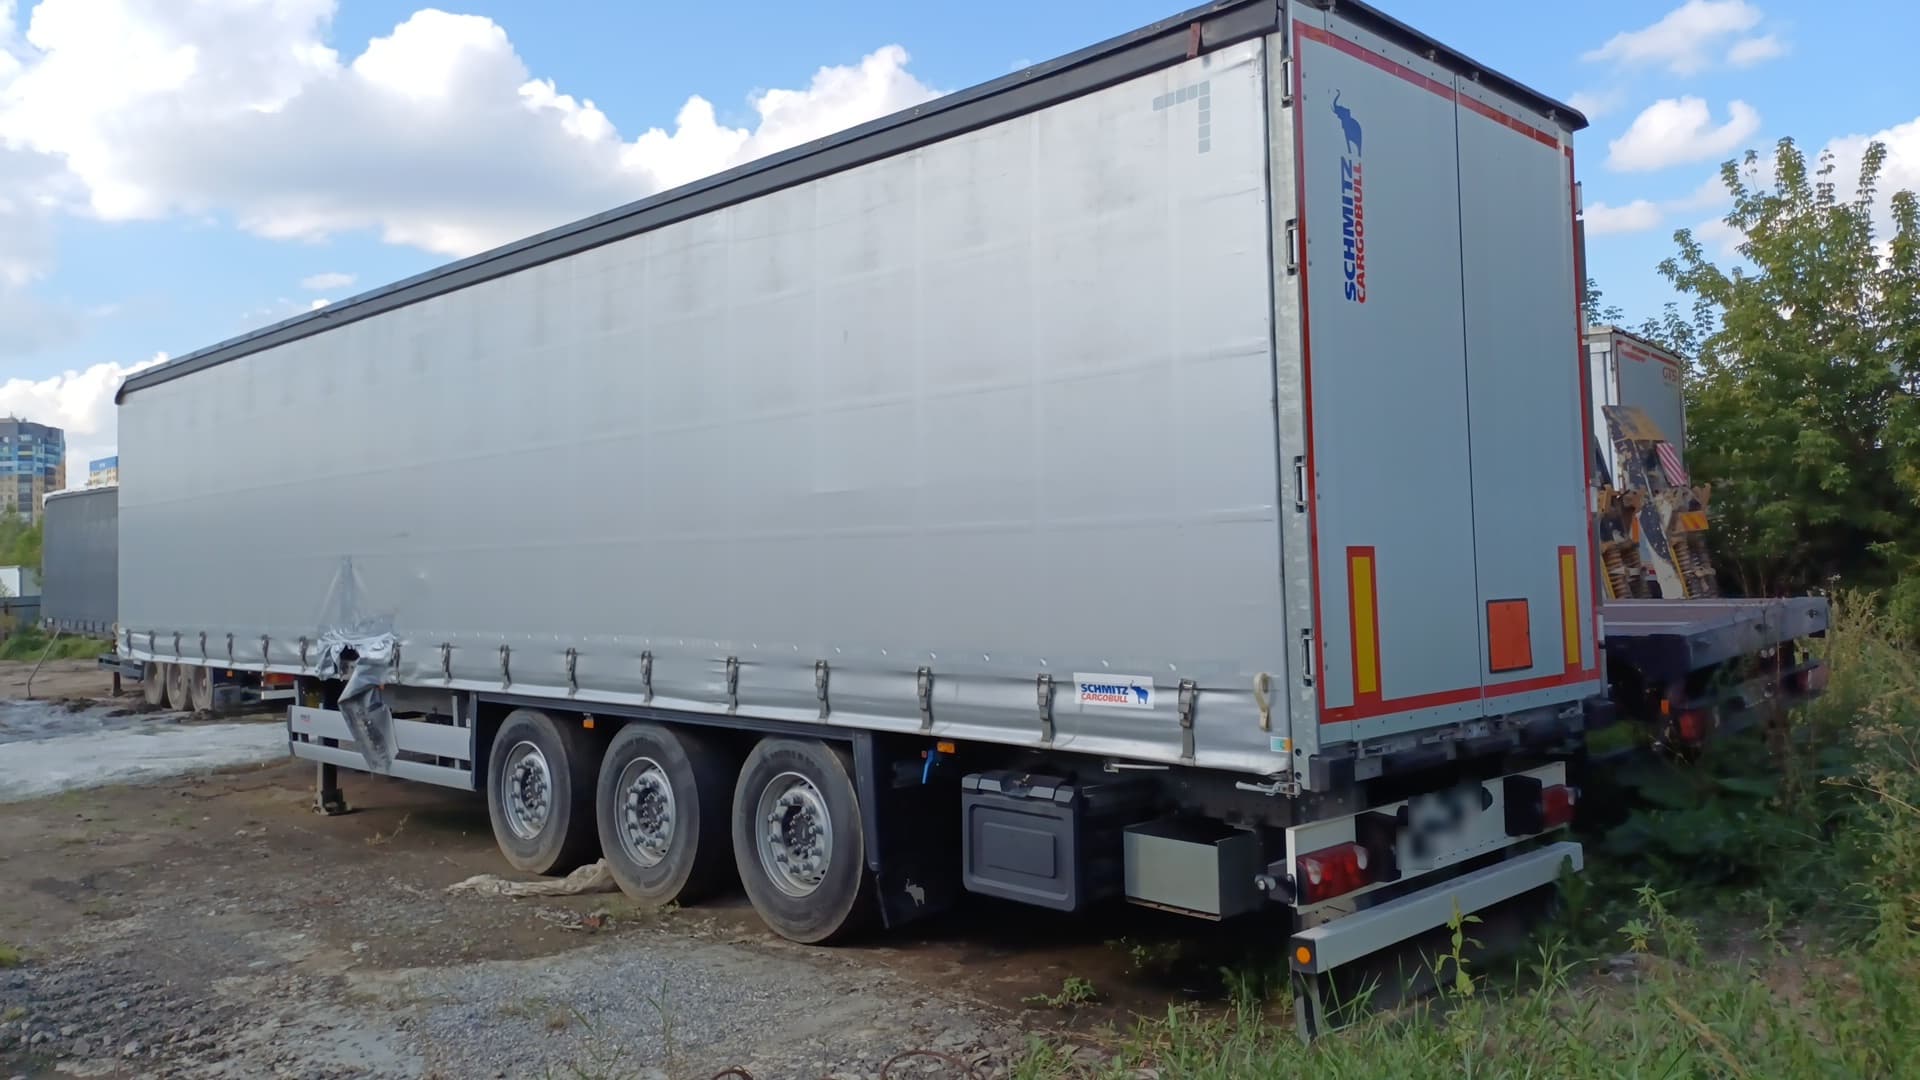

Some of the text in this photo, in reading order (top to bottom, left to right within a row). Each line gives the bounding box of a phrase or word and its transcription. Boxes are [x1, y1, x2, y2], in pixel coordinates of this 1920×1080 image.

[1341, 156, 1357, 301] SCHMITZ
[1353, 162, 1367, 304] CARGOBULL
[1080, 683, 1129, 695] SCHMITZ
[1081, 693, 1129, 703] CARGOBULL
